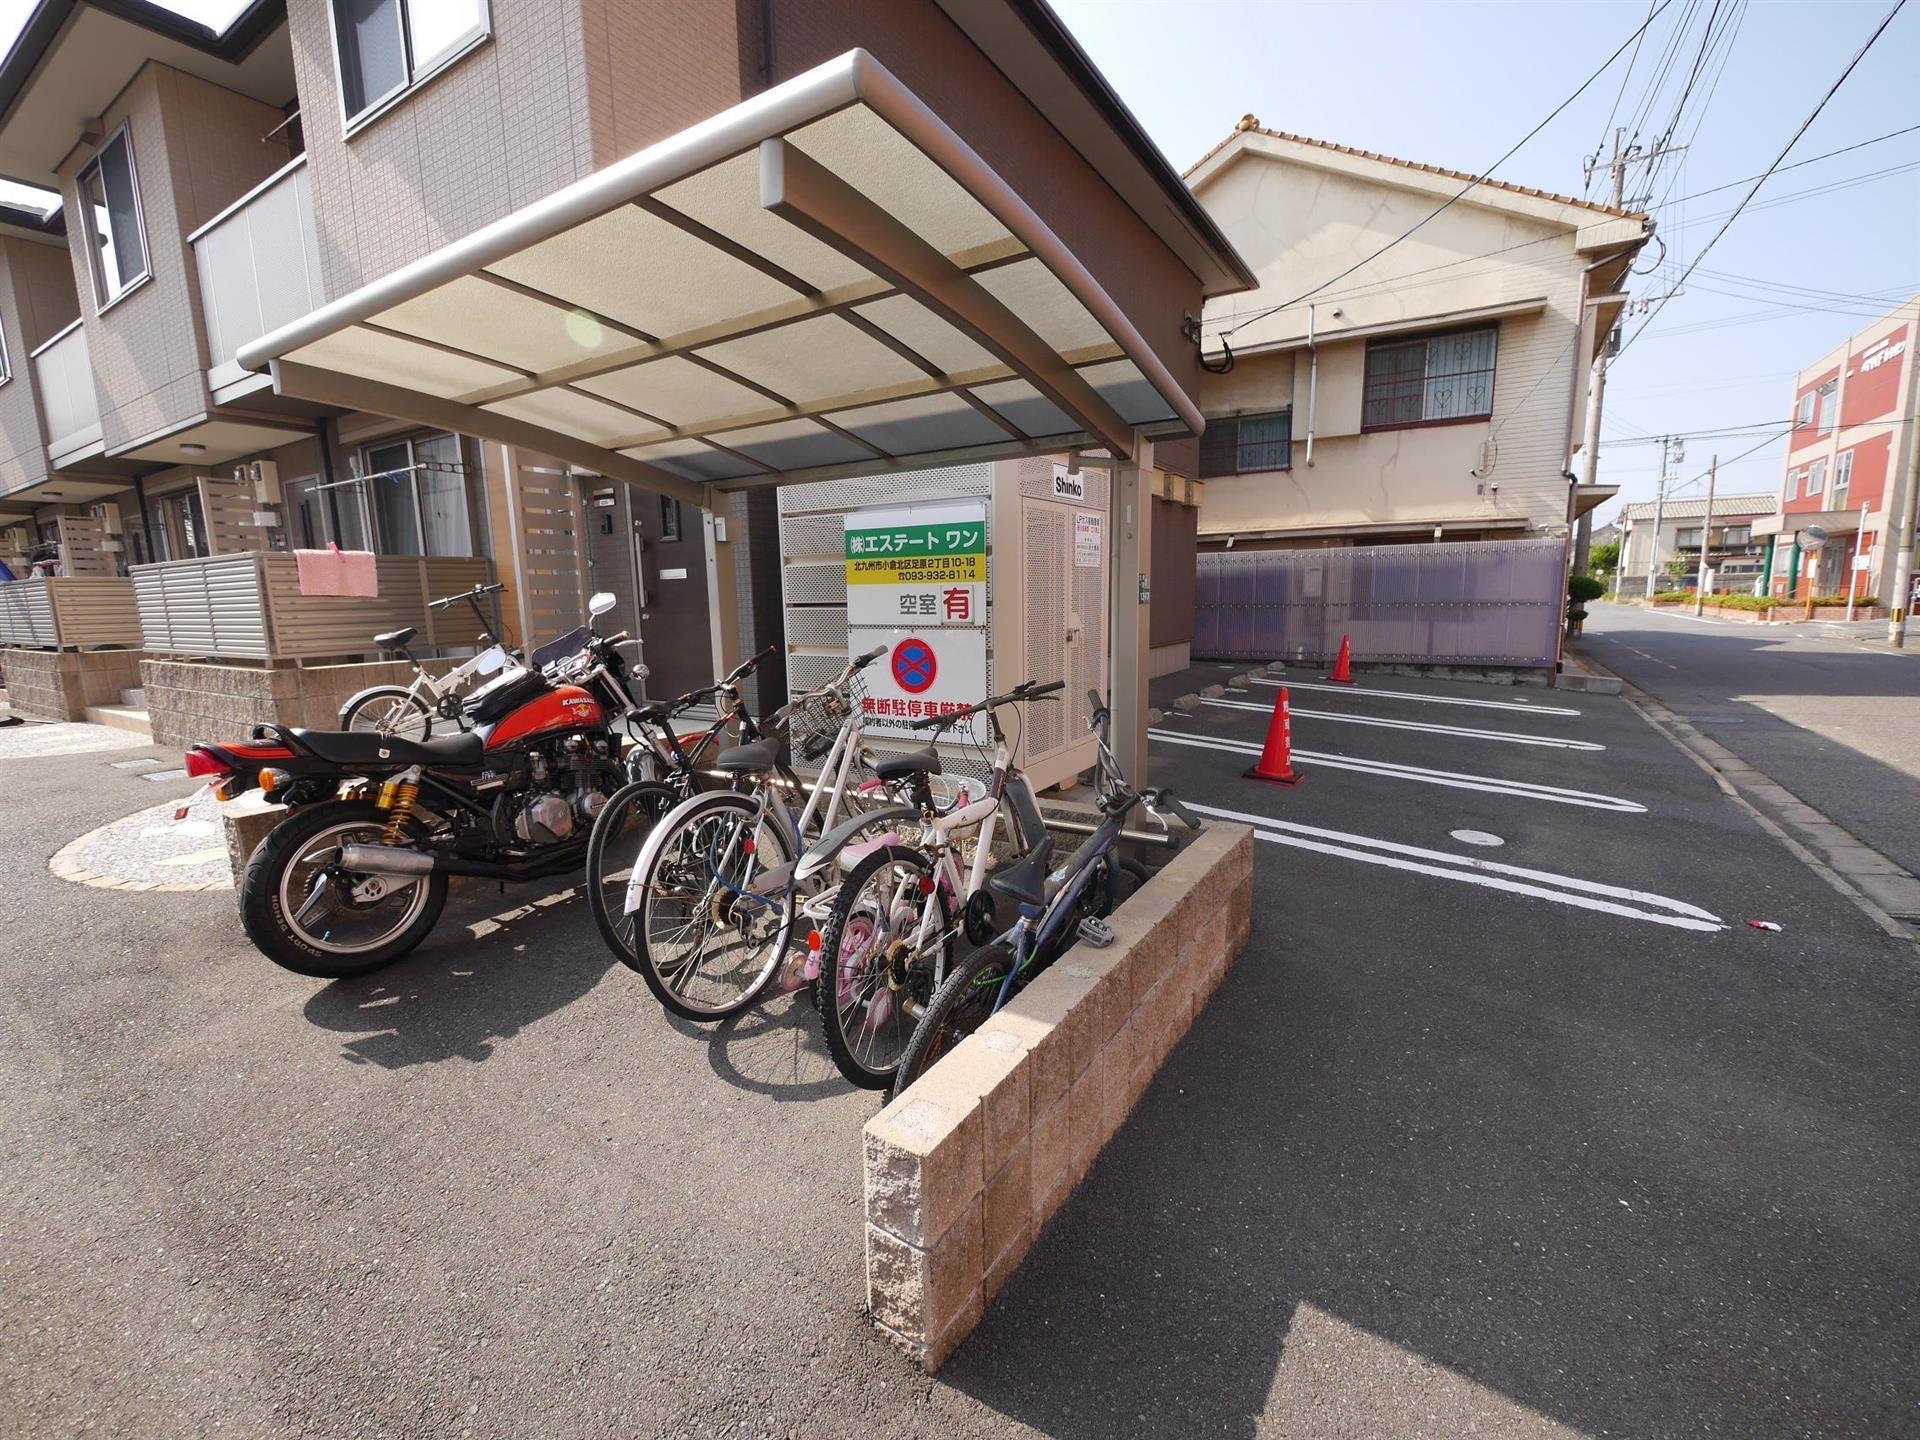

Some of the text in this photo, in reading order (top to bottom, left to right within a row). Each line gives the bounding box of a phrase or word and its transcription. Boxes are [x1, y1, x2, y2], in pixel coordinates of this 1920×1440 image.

[1056, 476, 1081, 497] Shinko
[946, 531, 978, 549] ワン
[900, 588, 970, 619] 空室 有
[272, 895, 323, 957] SPORT DEMON
